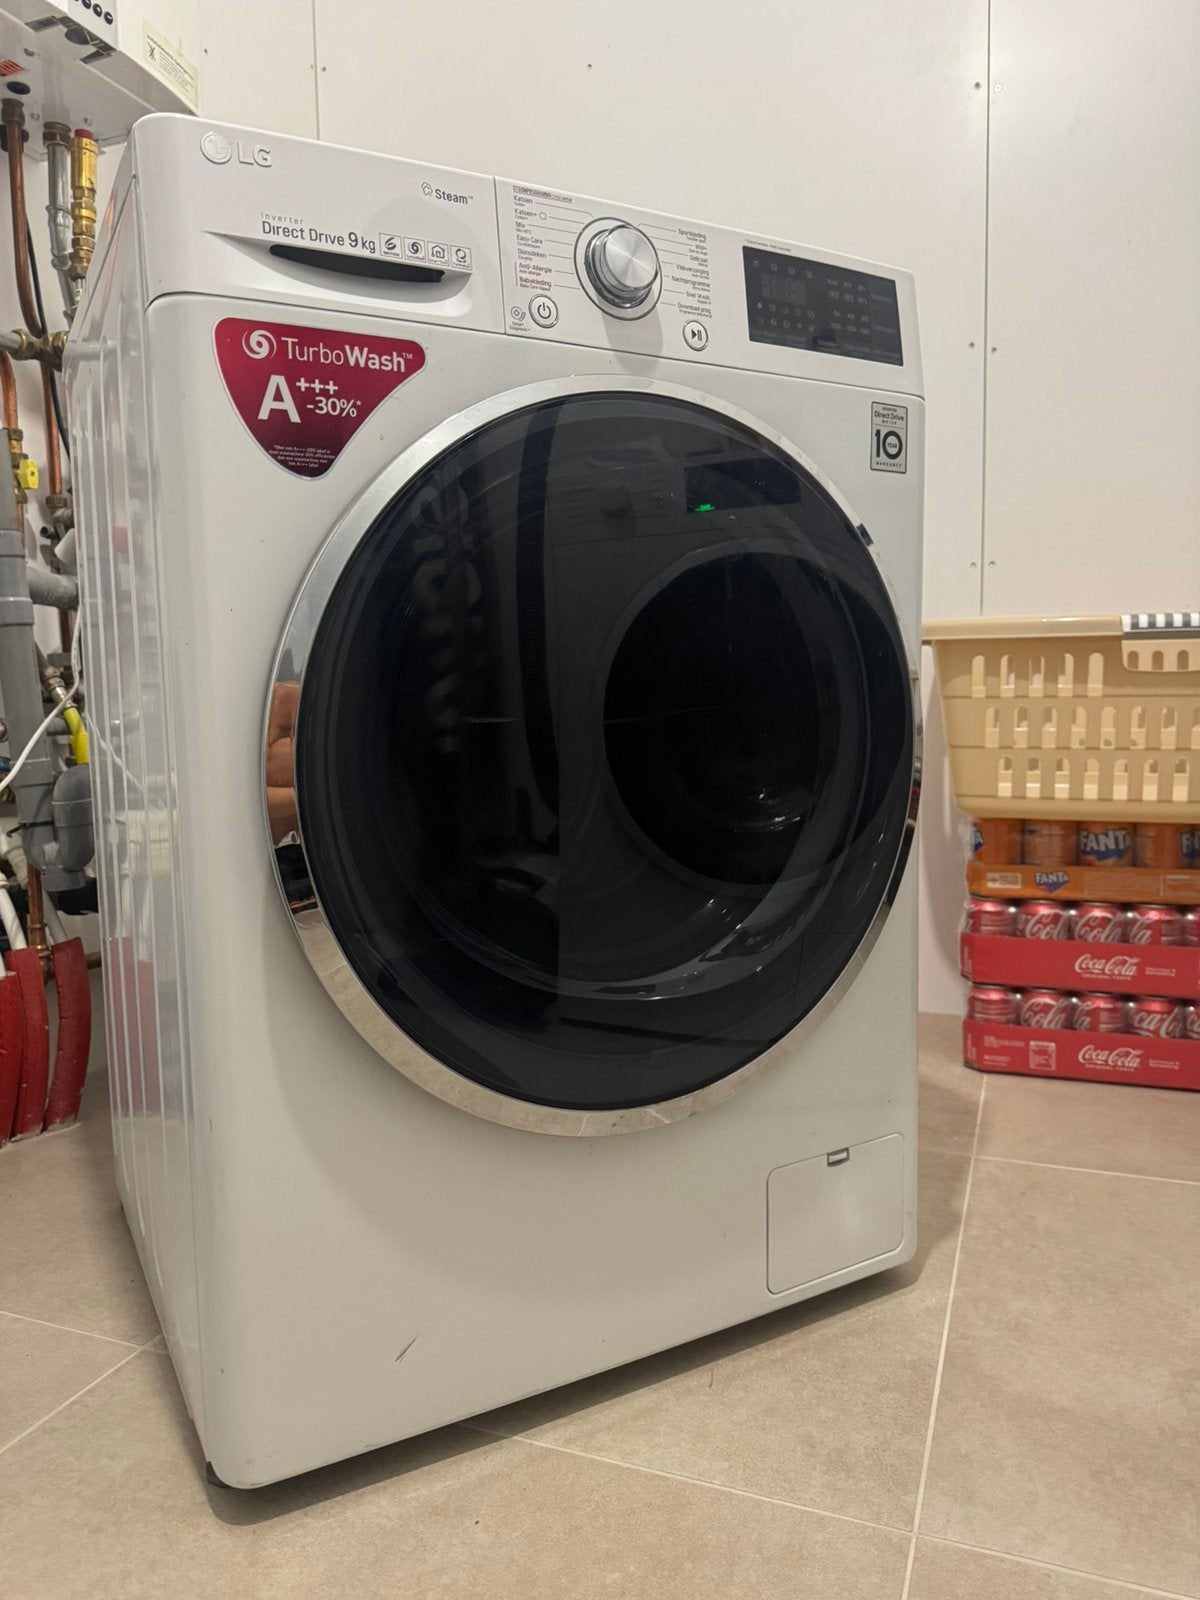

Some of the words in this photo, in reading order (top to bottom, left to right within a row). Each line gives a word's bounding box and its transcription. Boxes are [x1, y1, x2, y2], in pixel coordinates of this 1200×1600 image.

[236, 141, 272, 168] LG
[261, 211, 304, 226] Inverter
[262, 221, 305, 240] Direct
[309, 228, 345, 247] Drive
[347, 232, 359, 248] 9
[361, 237, 377, 254] kg
[874, 410, 890, 420] Direct
[890, 413, 905, 422] Drive
[874, 429, 903, 460] 10
